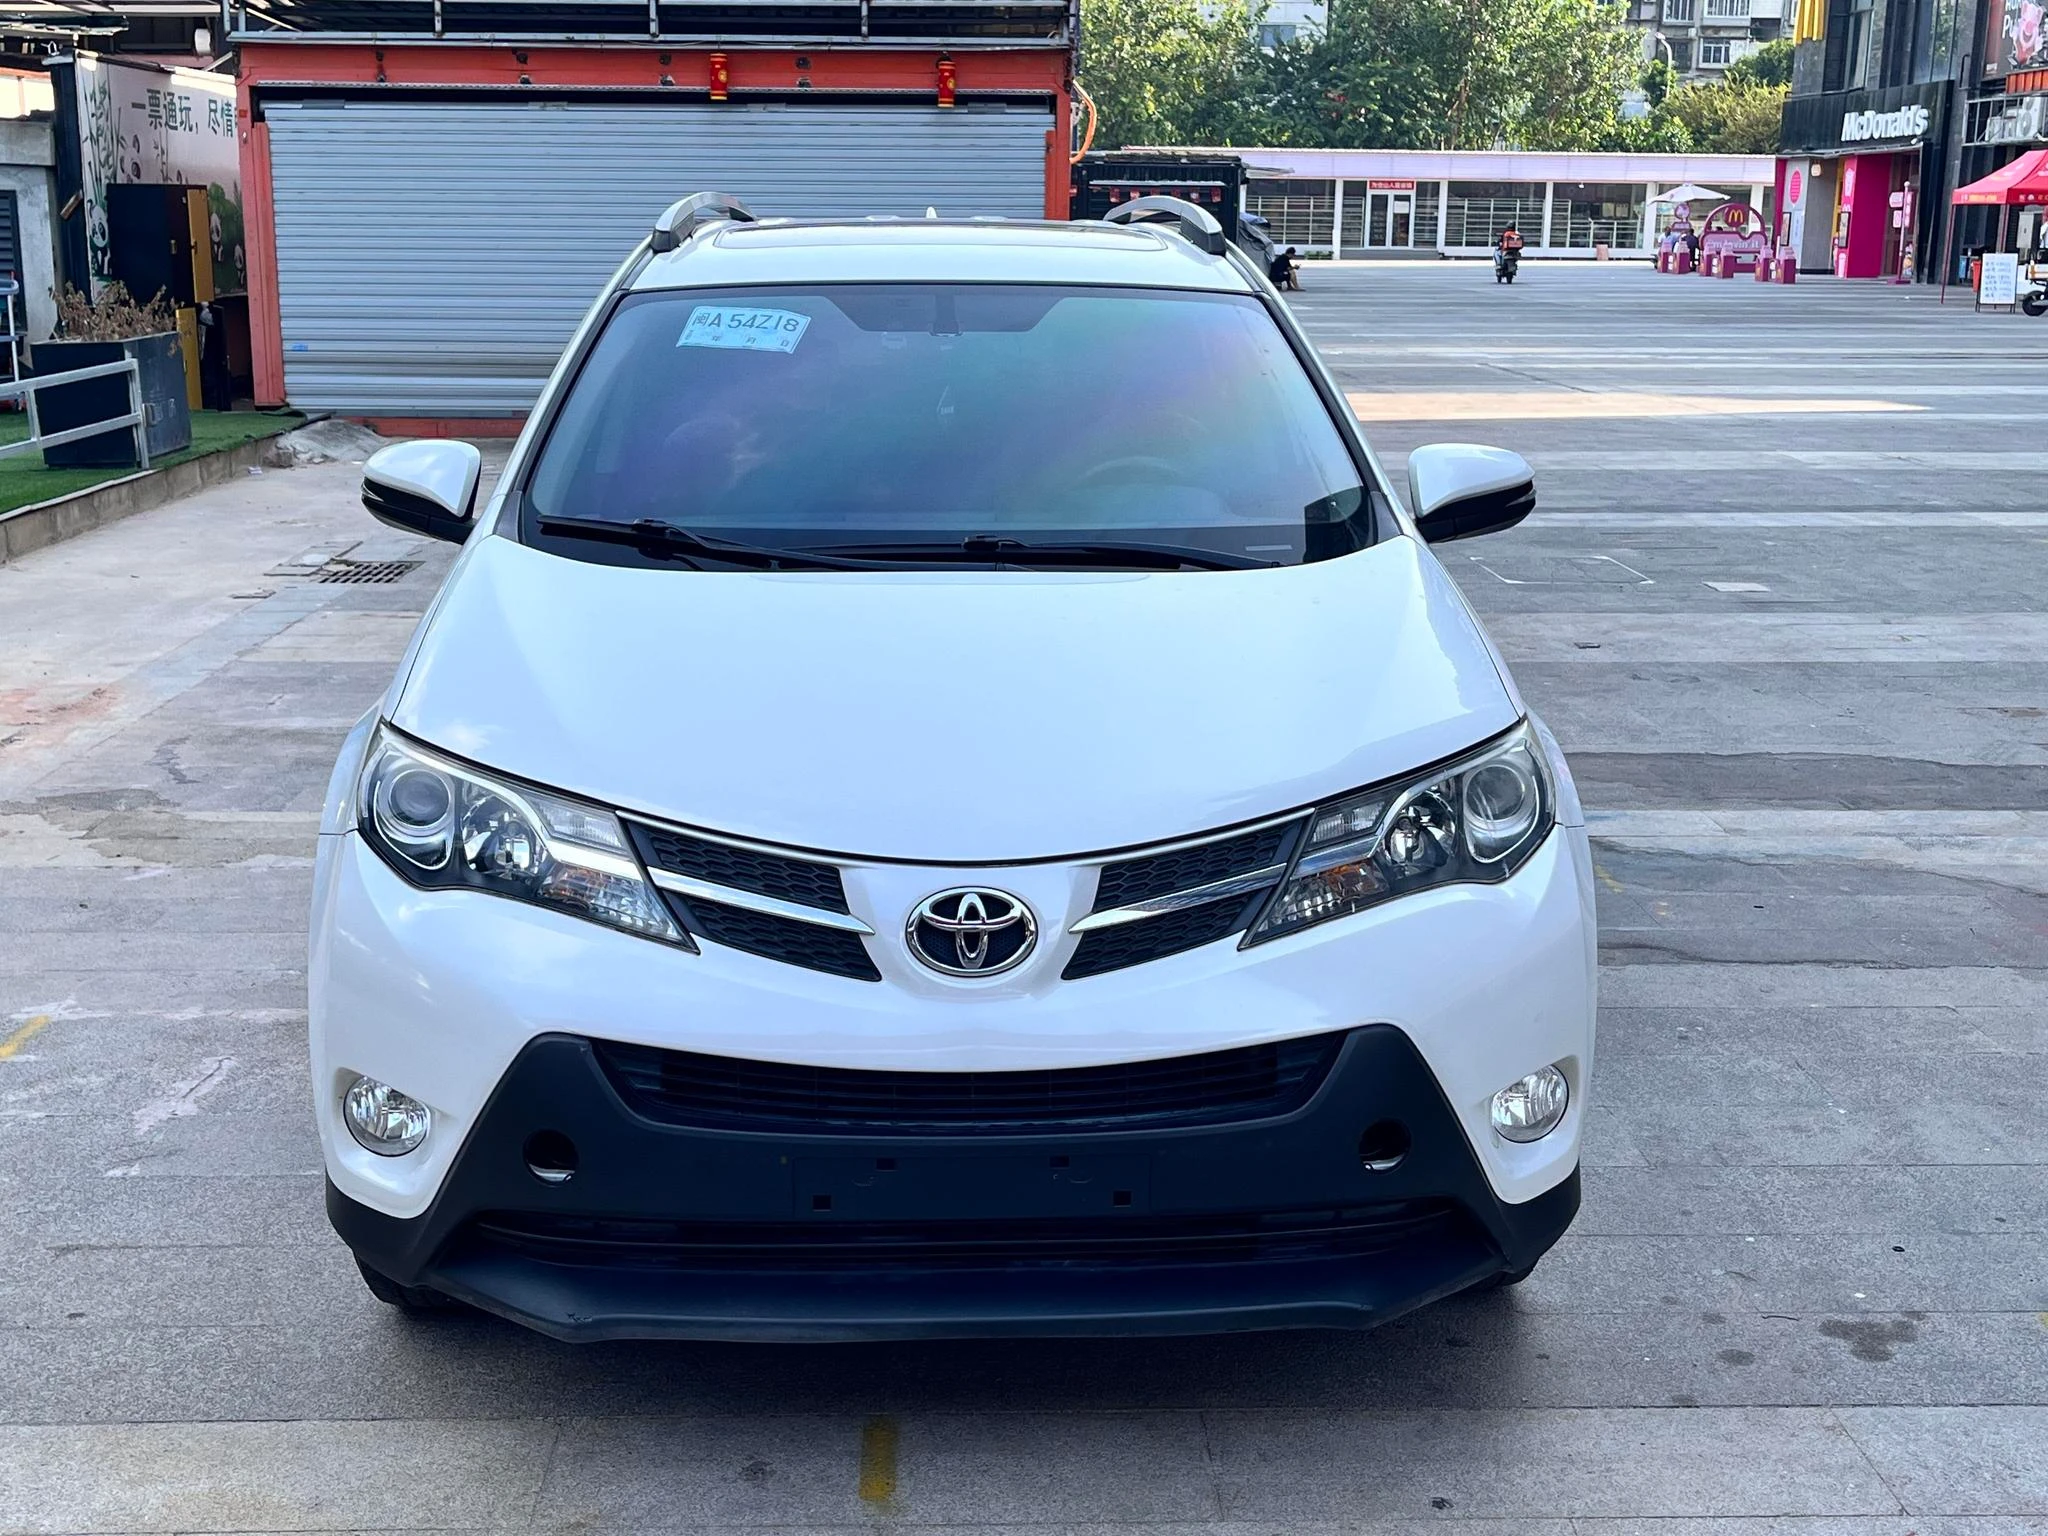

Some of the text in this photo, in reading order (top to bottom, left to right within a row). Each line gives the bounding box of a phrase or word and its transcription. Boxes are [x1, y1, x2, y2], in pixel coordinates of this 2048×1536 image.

[132, 88, 238, 138] 一票通玩，尽情
[1841, 104, 1929, 142] McDonald's
[692, 312, 800, 332] 闽A 54Z18
